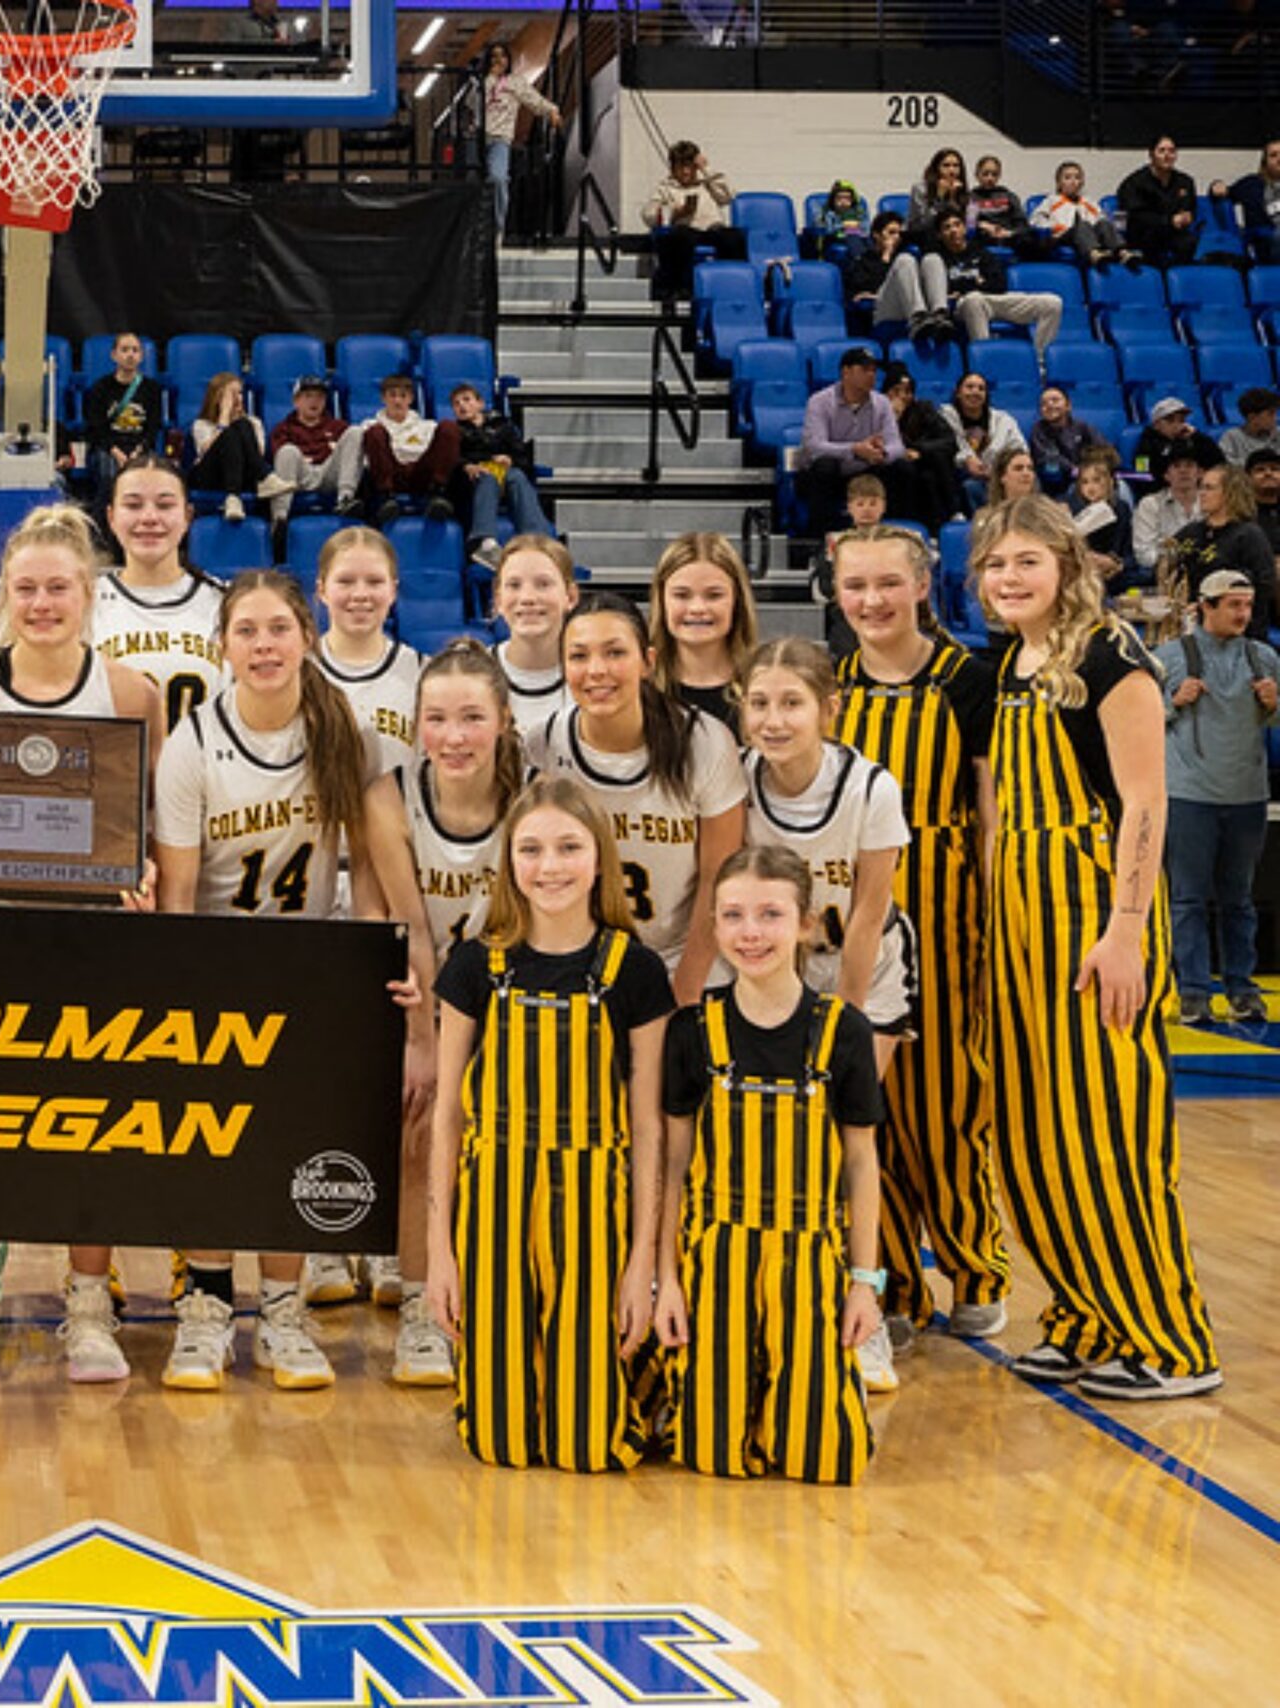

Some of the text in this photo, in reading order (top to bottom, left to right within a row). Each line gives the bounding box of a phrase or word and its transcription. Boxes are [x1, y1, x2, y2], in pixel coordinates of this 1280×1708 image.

[887, 95, 938, 129] 208
[209, 794, 317, 841] COLMAN-E
[612, 813, 697, 845] N-EGAN
[1, 864, 67, 879] EIGHTH
[69, 866, 124, 882] PLACE
[230, 841, 314, 914] 14
